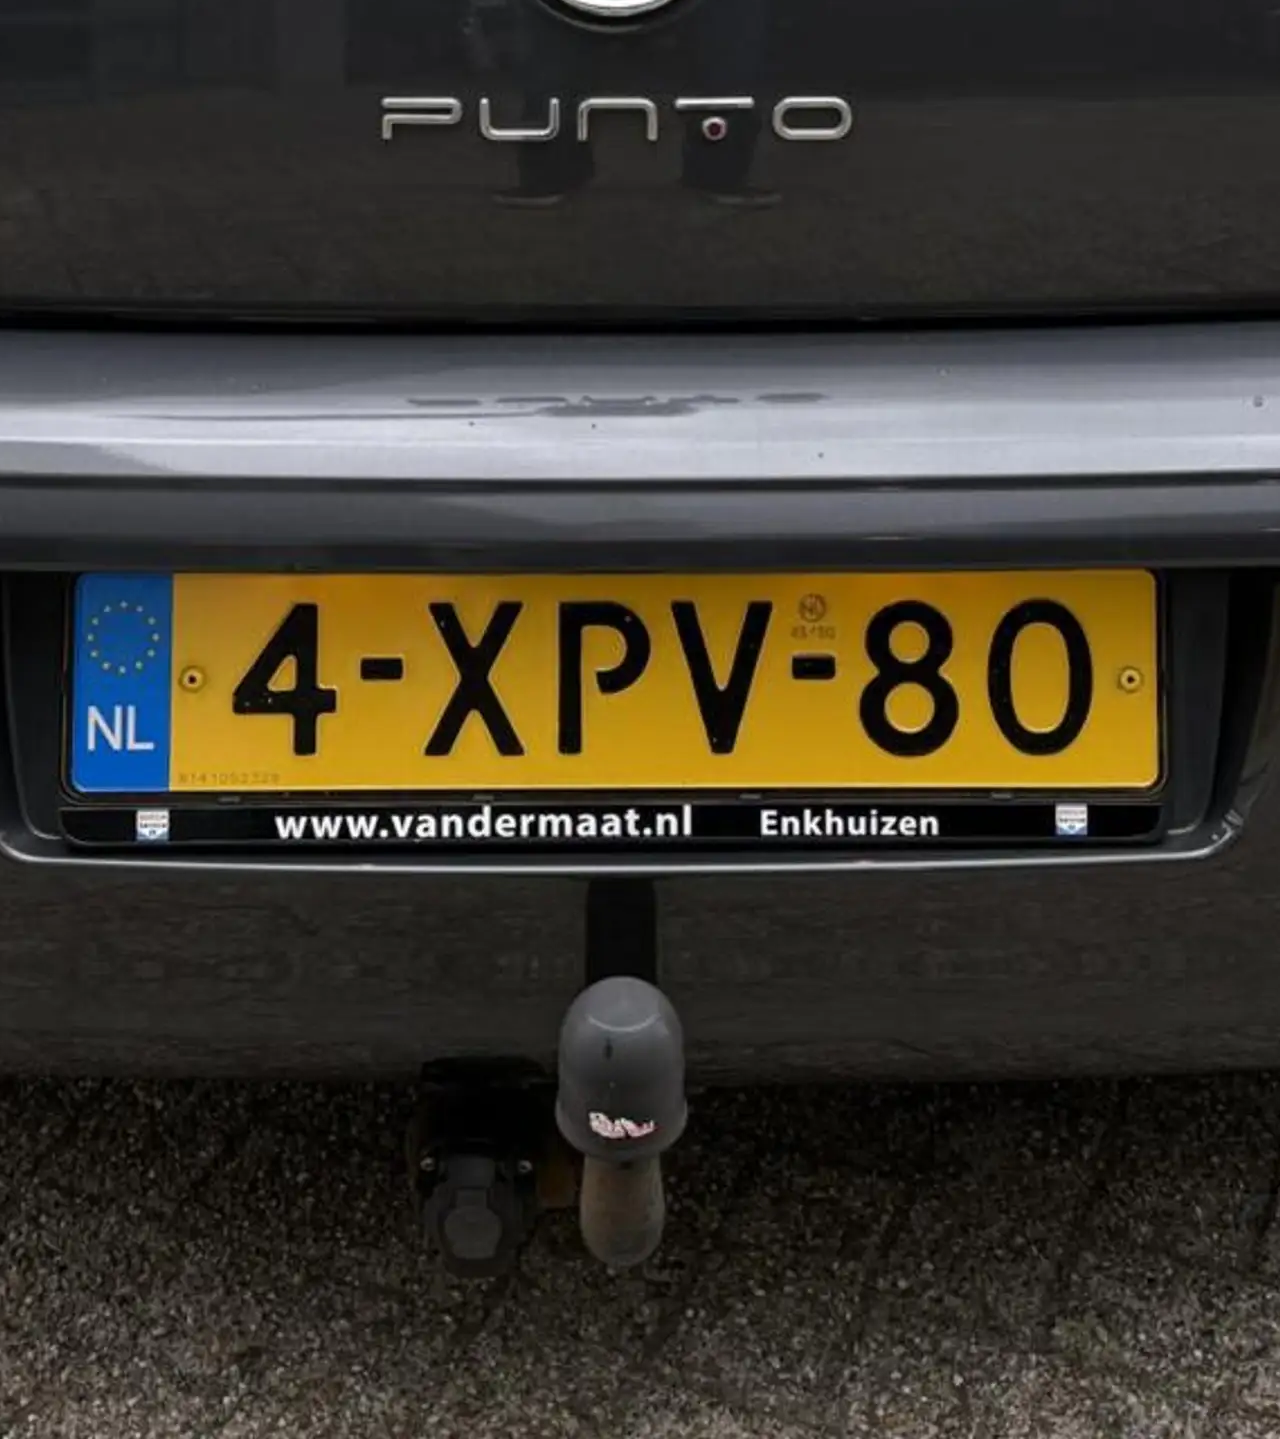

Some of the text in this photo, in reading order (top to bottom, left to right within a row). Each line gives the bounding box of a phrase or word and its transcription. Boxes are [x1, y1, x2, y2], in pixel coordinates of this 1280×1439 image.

[382, 97, 852, 141] PUNTO
[232, 599, 1093, 756] 4-XPV-80
[87, 705, 154, 751] NL
[274, 804, 939, 839] www.vandermaat.nl Enkhuizen
